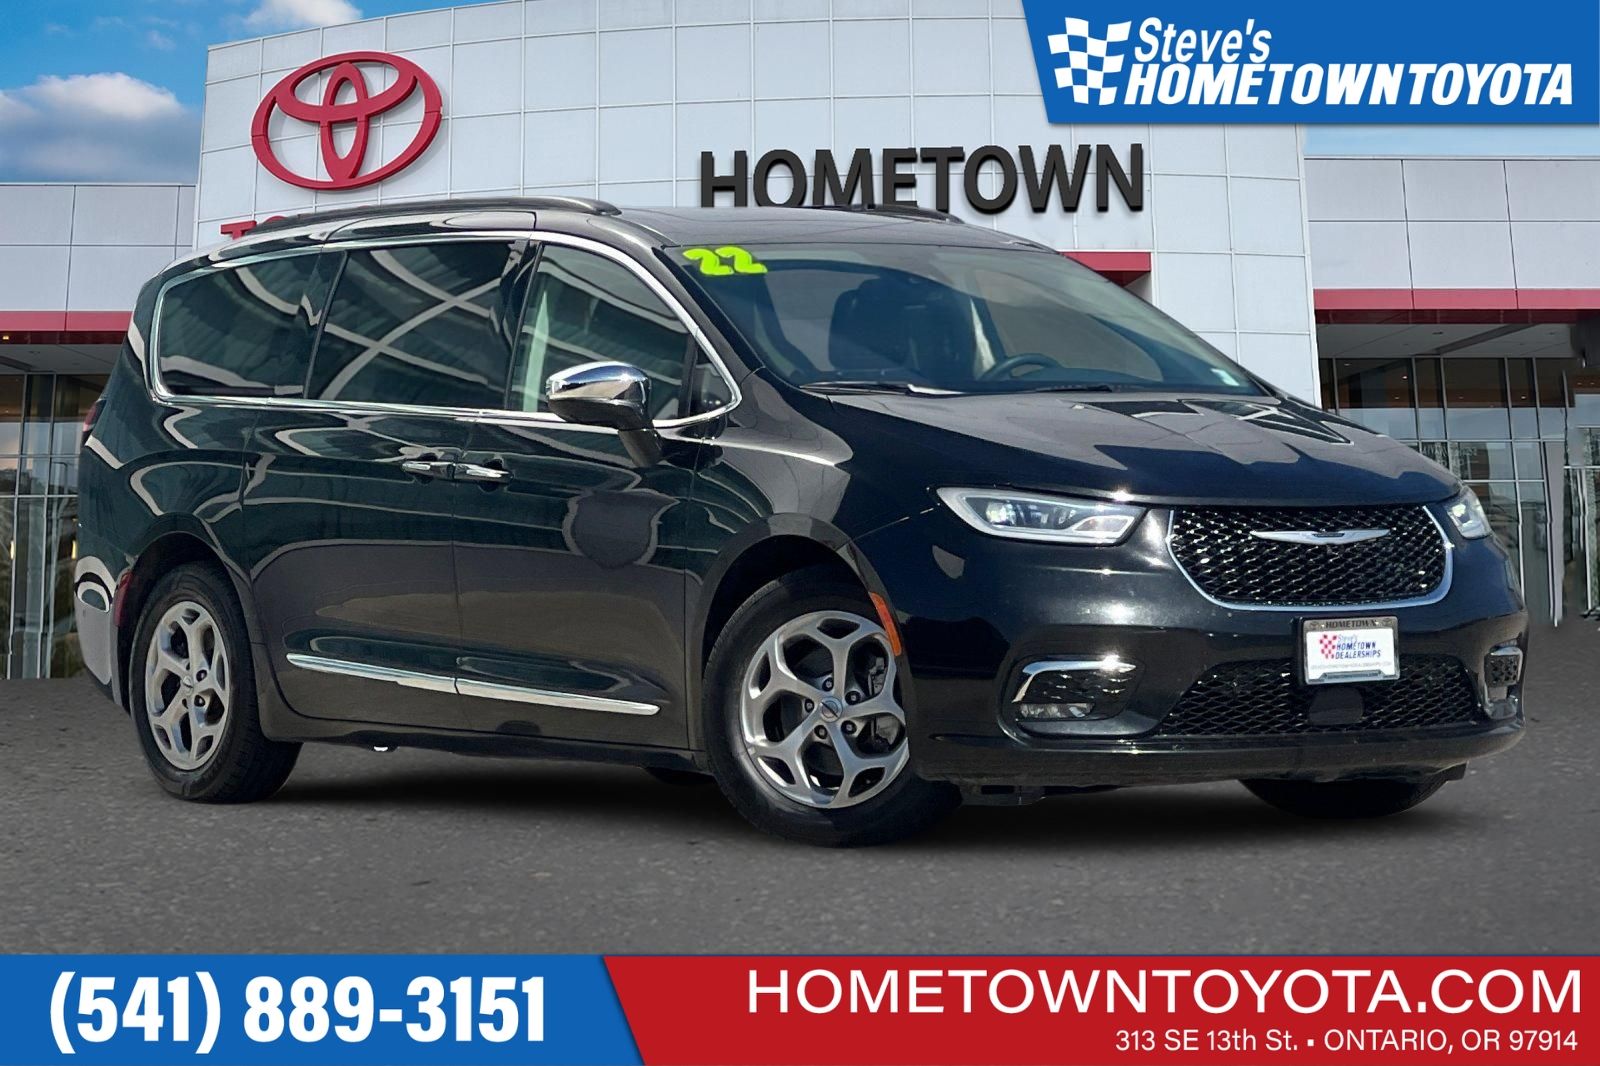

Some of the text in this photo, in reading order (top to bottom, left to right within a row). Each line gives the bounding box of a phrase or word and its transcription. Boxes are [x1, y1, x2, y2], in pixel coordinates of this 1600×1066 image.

[700, 144, 1144, 214] HOMETOWN
[684, 246, 767, 276] 22
[1325, 619, 1378, 629] HOMETOWN
[1336, 641, 1376, 651] HOMETOWN
[1335, 649, 1381, 660] DEALERSHIPS
